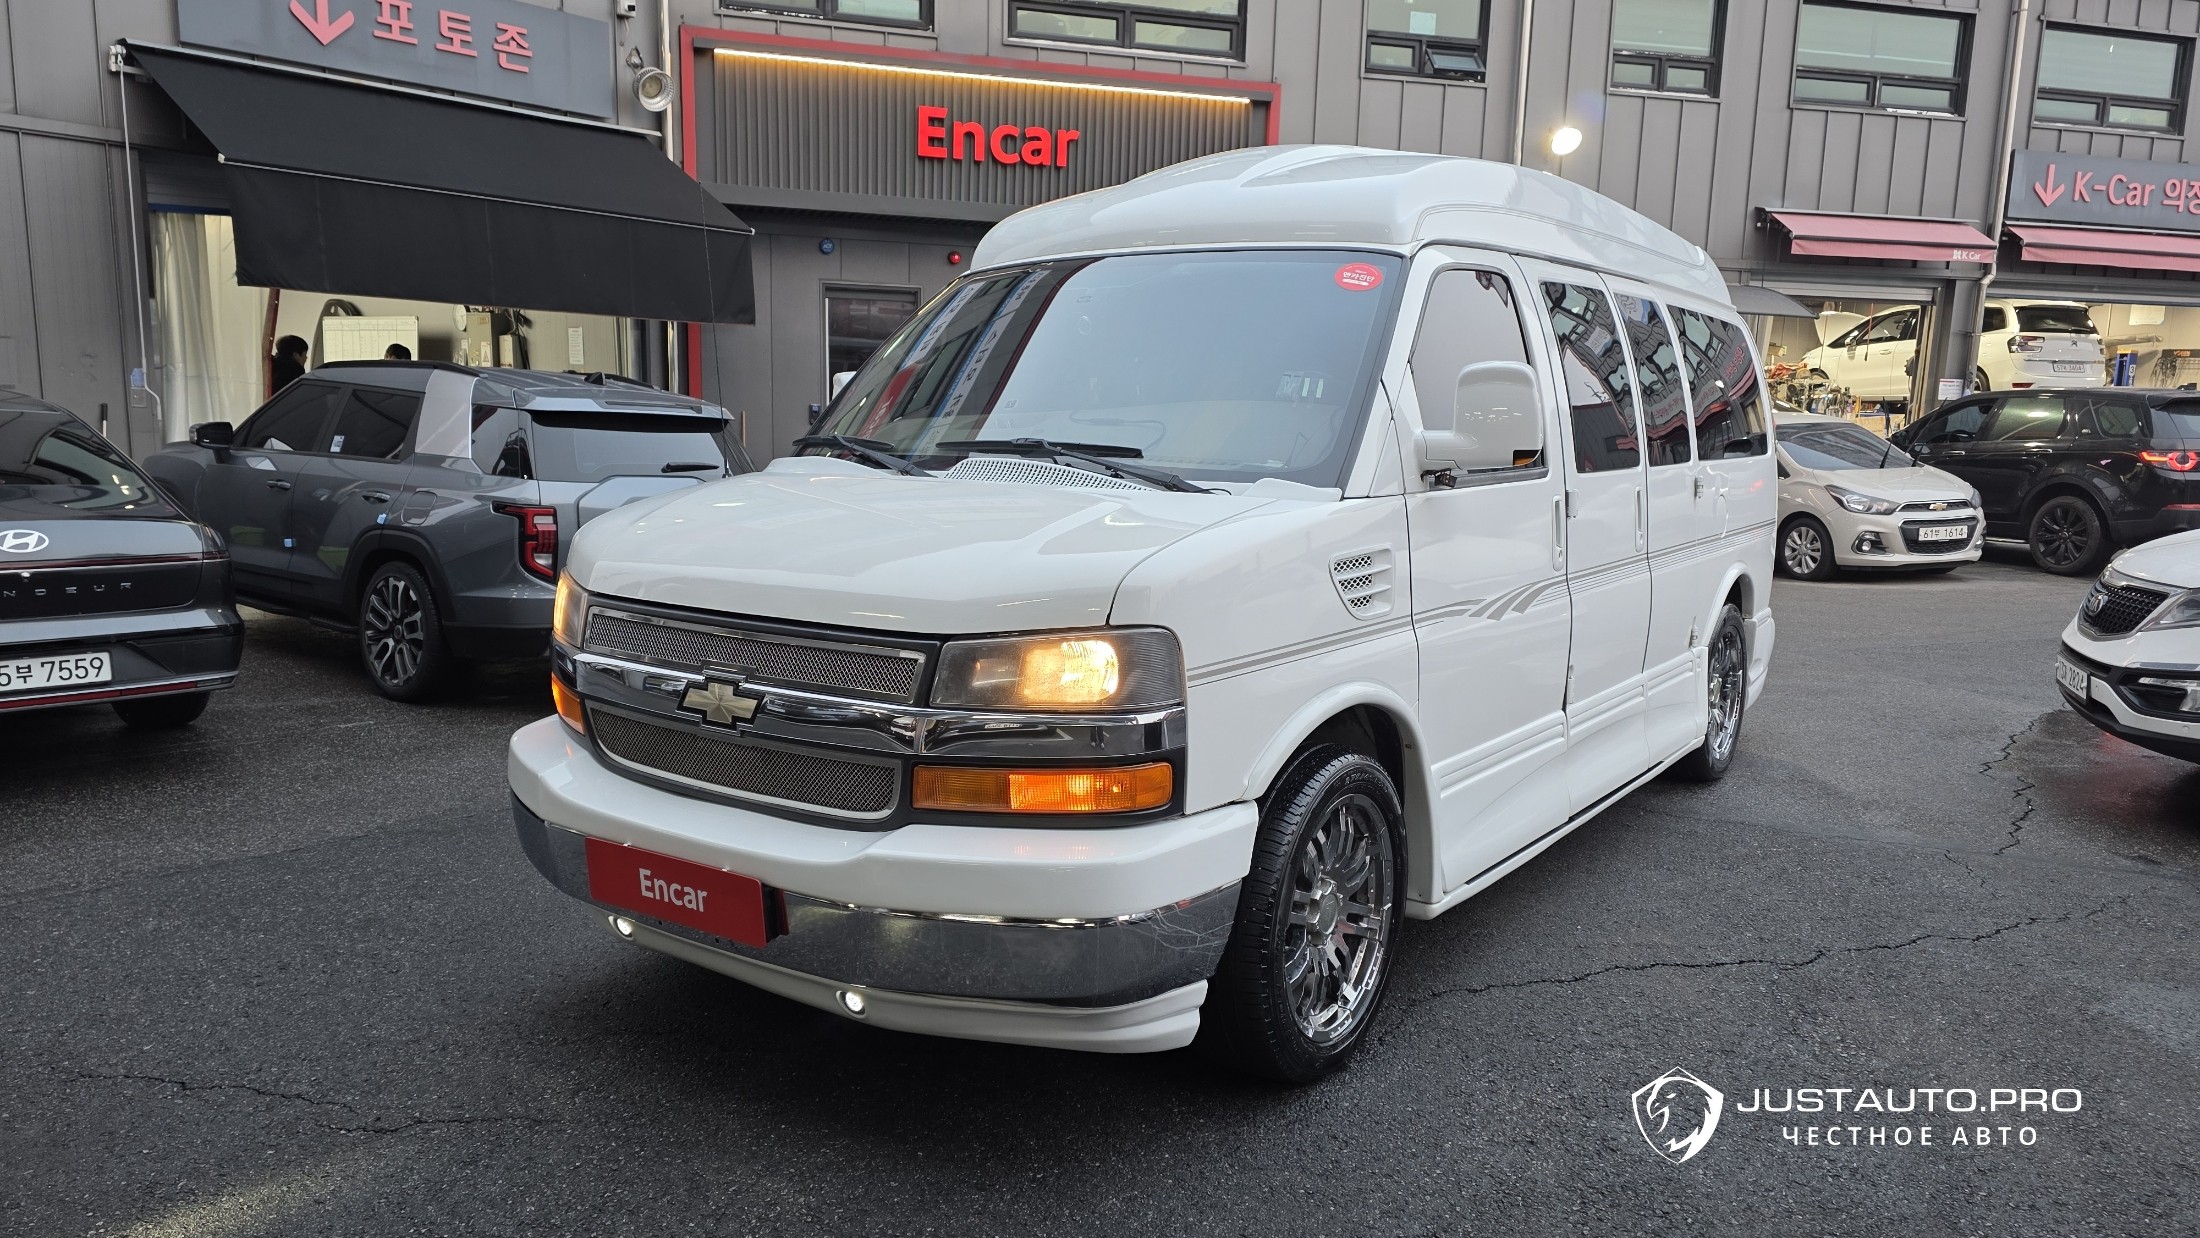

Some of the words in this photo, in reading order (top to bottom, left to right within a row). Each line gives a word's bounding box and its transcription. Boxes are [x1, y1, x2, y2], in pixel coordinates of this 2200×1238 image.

[372, 0, 533, 73] 포토존
[917, 105, 1081, 168] Encar
[2073, 170, 2156, 207] K-Car
[1944, 527, 1964, 538] 1614
[40, 656, 104, 683] 7559
[638, 867, 708, 913] Encar
